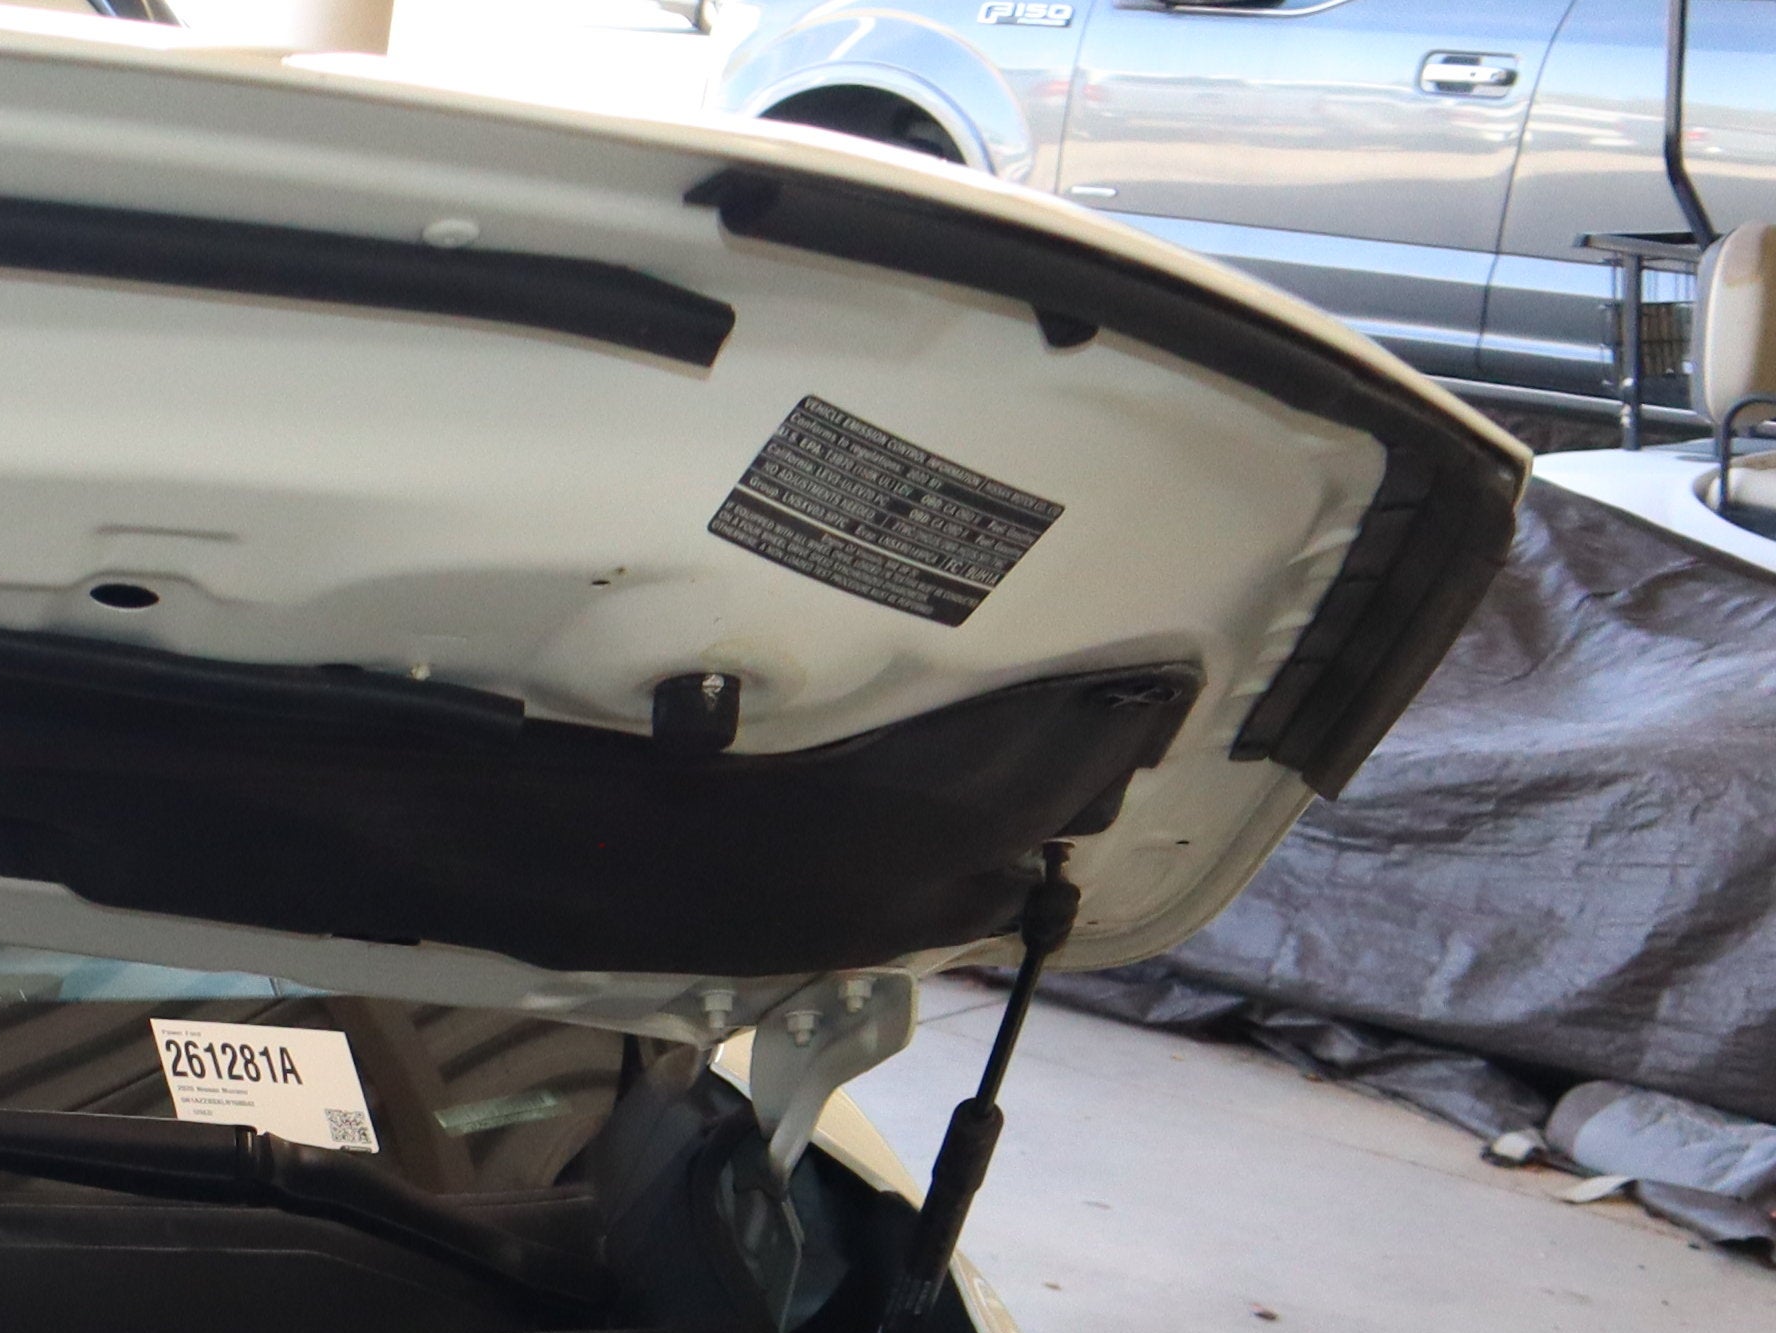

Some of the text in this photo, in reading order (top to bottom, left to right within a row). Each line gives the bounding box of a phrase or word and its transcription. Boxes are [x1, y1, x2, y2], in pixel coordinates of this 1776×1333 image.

[787, 409, 841, 443] Conforms
[799, 397, 984, 489] VEHICLE EMISSION CONTROL INFORMATION
[774, 468, 843, 507] ADJUSTMENTS
[836, 497, 878, 522] NEEDED
[165, 1039, 303, 1085] 261281A
